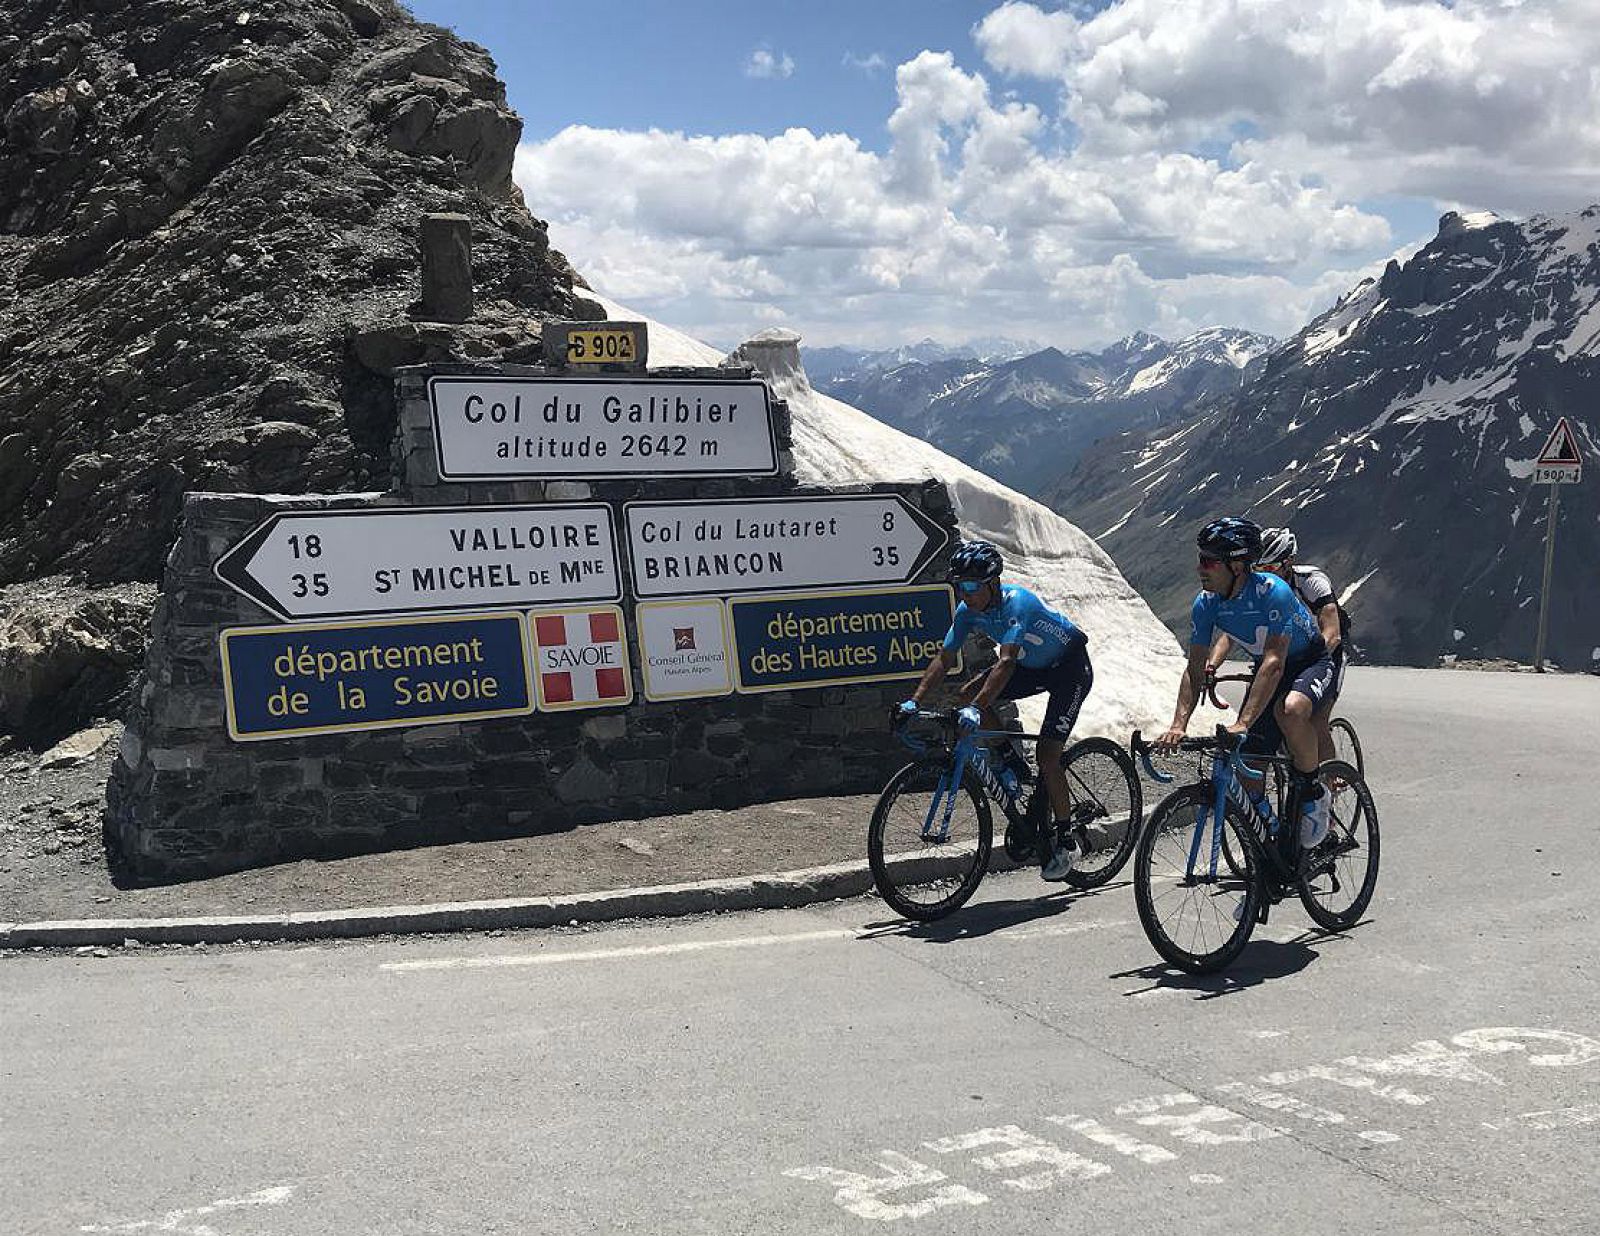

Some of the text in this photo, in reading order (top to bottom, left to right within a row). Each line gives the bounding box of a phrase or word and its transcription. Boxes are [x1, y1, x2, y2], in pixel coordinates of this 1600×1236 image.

[592, 335, 631, 357] 902
[465, 395, 738, 424] Col du Galibier
[497, 436, 719, 458] altitude 2642 m
[288, 525, 600, 558] 18 VALLOIRE
[642, 512, 895, 542] Col du Lautaret 8
[645, 546, 899, 579] BRIANÇON 35
[291, 573, 330, 598] 35
[413, 564, 520, 592] MICHEL
[529, 570, 550, 585] DE
[767, 606, 924, 643] département
[274, 636, 484, 680] département
[547, 646, 614, 669] SAVOIE
[648, 653, 685, 667] Conseil
[750, 650, 792, 675] des
[799, 643, 877, 671] Hautes
[267, 675, 498, 717] de la Savoie
